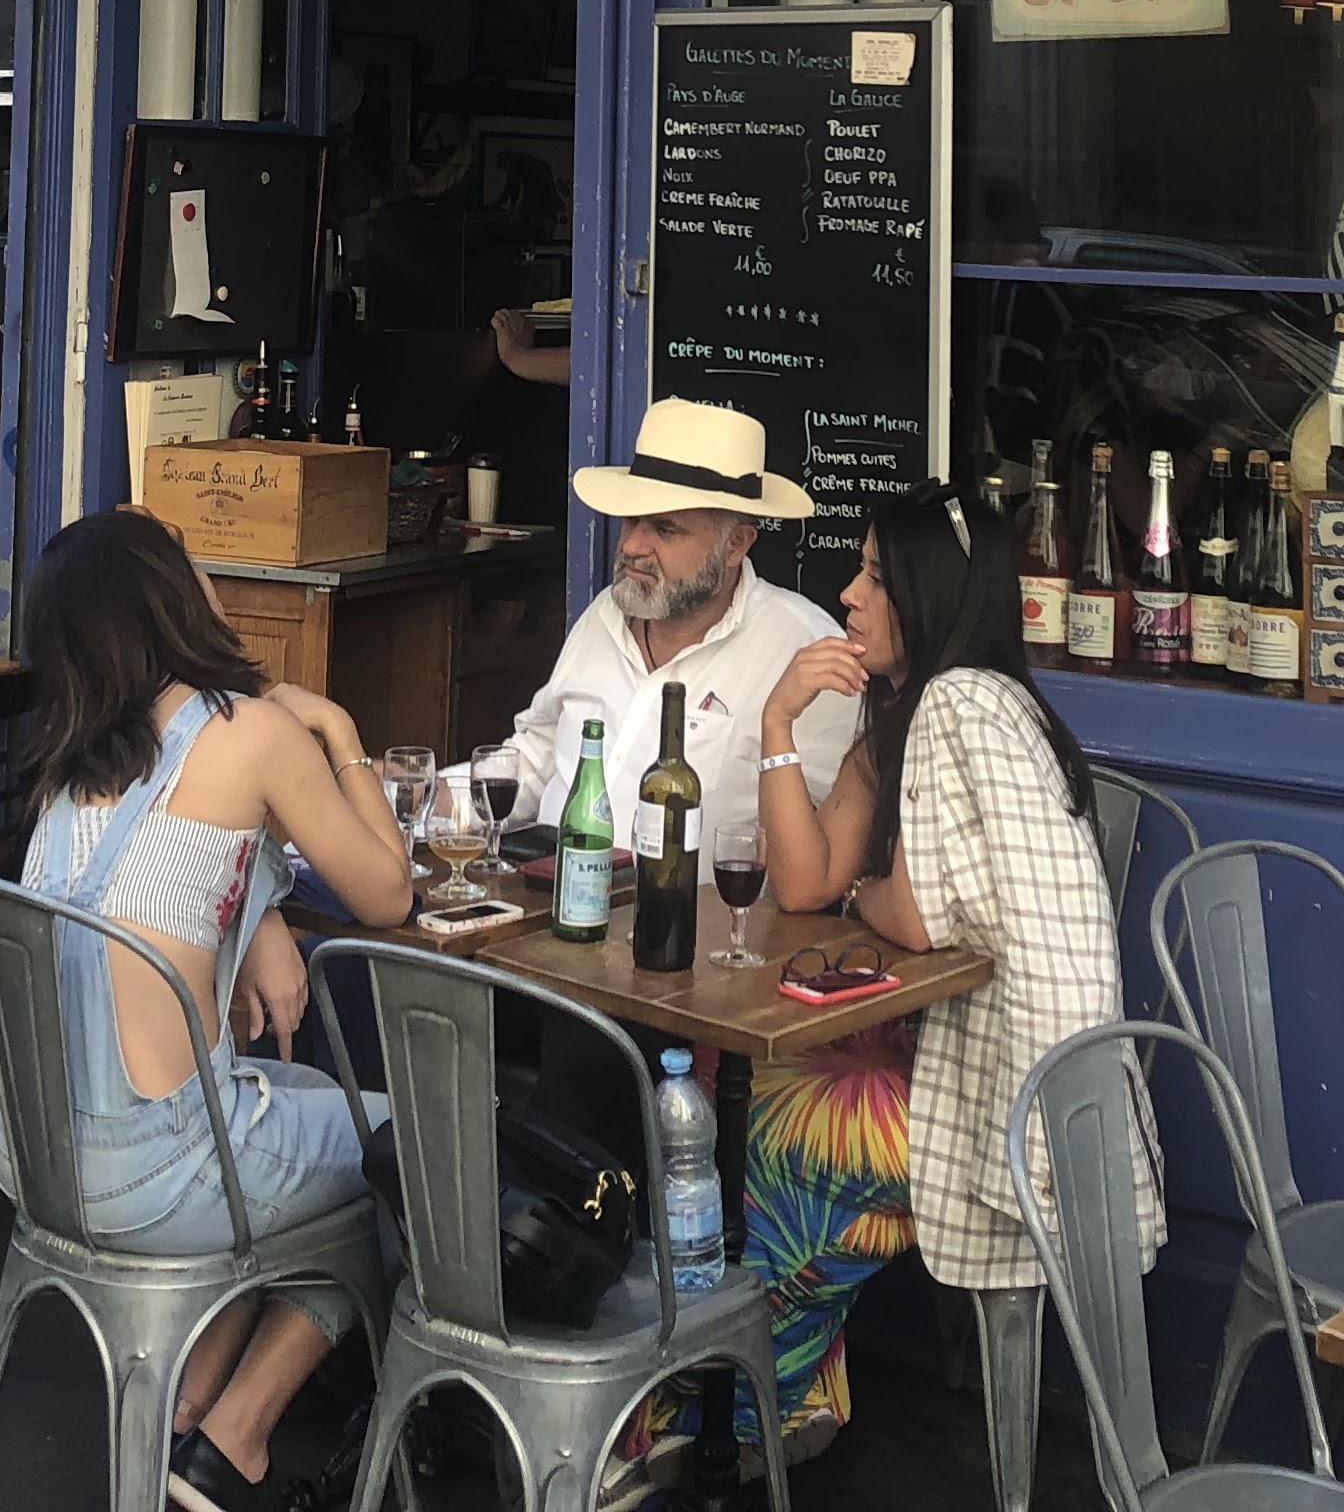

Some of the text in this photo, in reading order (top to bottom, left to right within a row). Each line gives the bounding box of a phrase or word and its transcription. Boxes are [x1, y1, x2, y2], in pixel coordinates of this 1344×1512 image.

[685, 41, 756, 65] GALETTES
[760, 50, 782, 66] DU
[667, 83, 746, 104] PAYS D'AUGE
[829, 89, 847, 106] LA
[663, 118, 806, 137] CAMEMBERT NORMAND
[825, 119, 882, 139] POULET
[663, 144, 723, 161] LARDONS
[823, 145, 887, 164] CHORIZO
[662, 167, 694, 183] NOIX
[823, 168, 898, 188] OEUF PPA
[708, 191, 762, 211] FRAÎCHE
[821, 190, 911, 215] RATATOUILLE
[658, 217, 755, 239] SALADE VERTE
[816, 213, 926, 240] FROMAGE RAPÉ
[734, 254, 774, 277] 11,00
[667, 336, 714, 361] CRÊPE
[723, 345, 744, 361] DU
[812, 411, 922, 435] LA SAINT MICHEL
[811, 445, 897, 470] POMMES CUITES
[814, 503, 863, 518] RUMBLE
[808, 532, 861, 551] CARAME
[1251, 618, 1286, 634] ORRE
